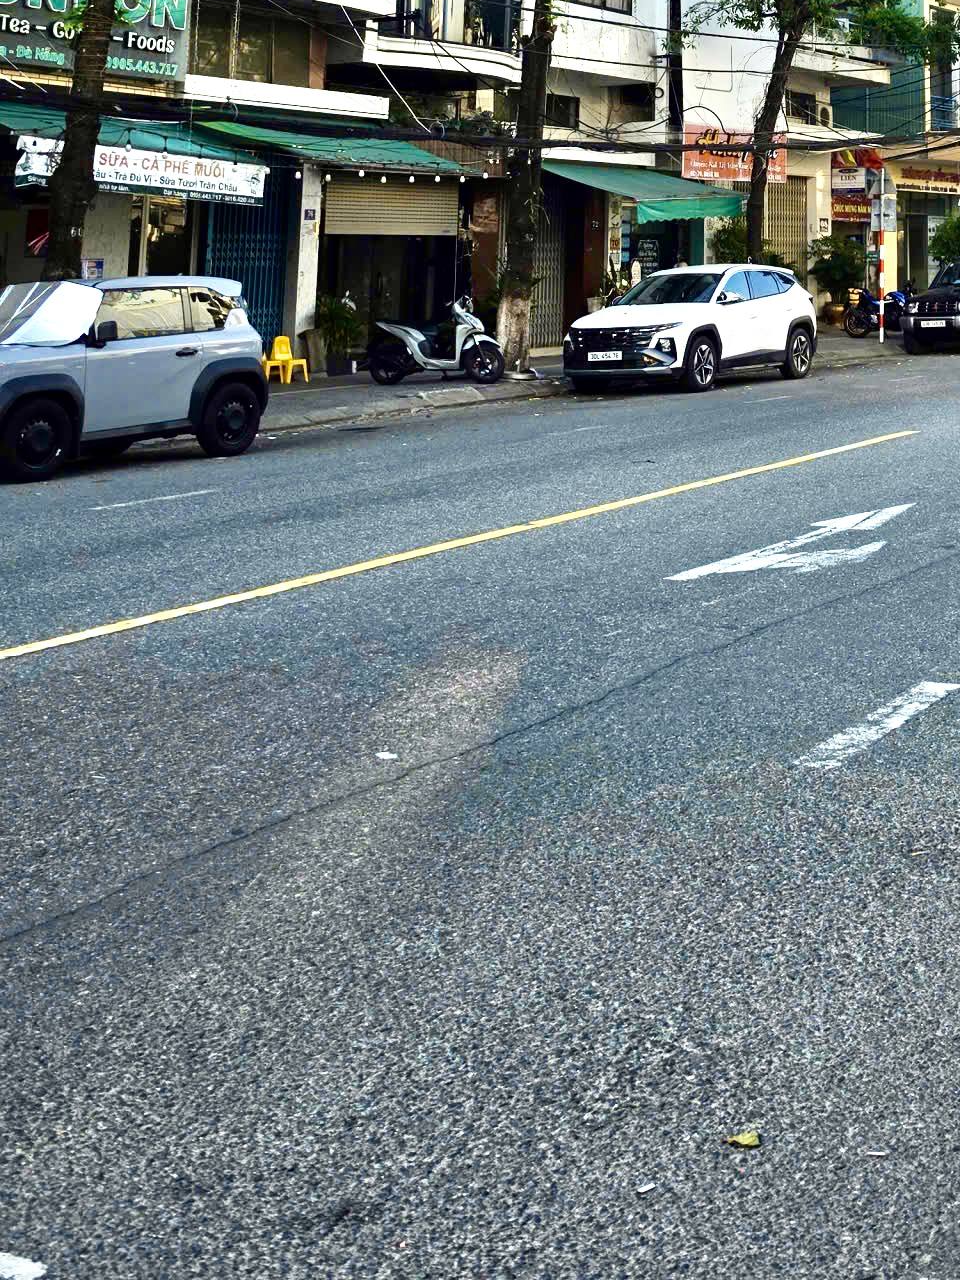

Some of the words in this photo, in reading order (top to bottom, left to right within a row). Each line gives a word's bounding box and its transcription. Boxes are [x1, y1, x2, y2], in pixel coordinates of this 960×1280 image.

[0, 14, 30, 35] Tea
[127, 31, 176, 54] Foods
[98, 150, 129, 169] SỮA
[194, 160, 225, 178] MUỐI
